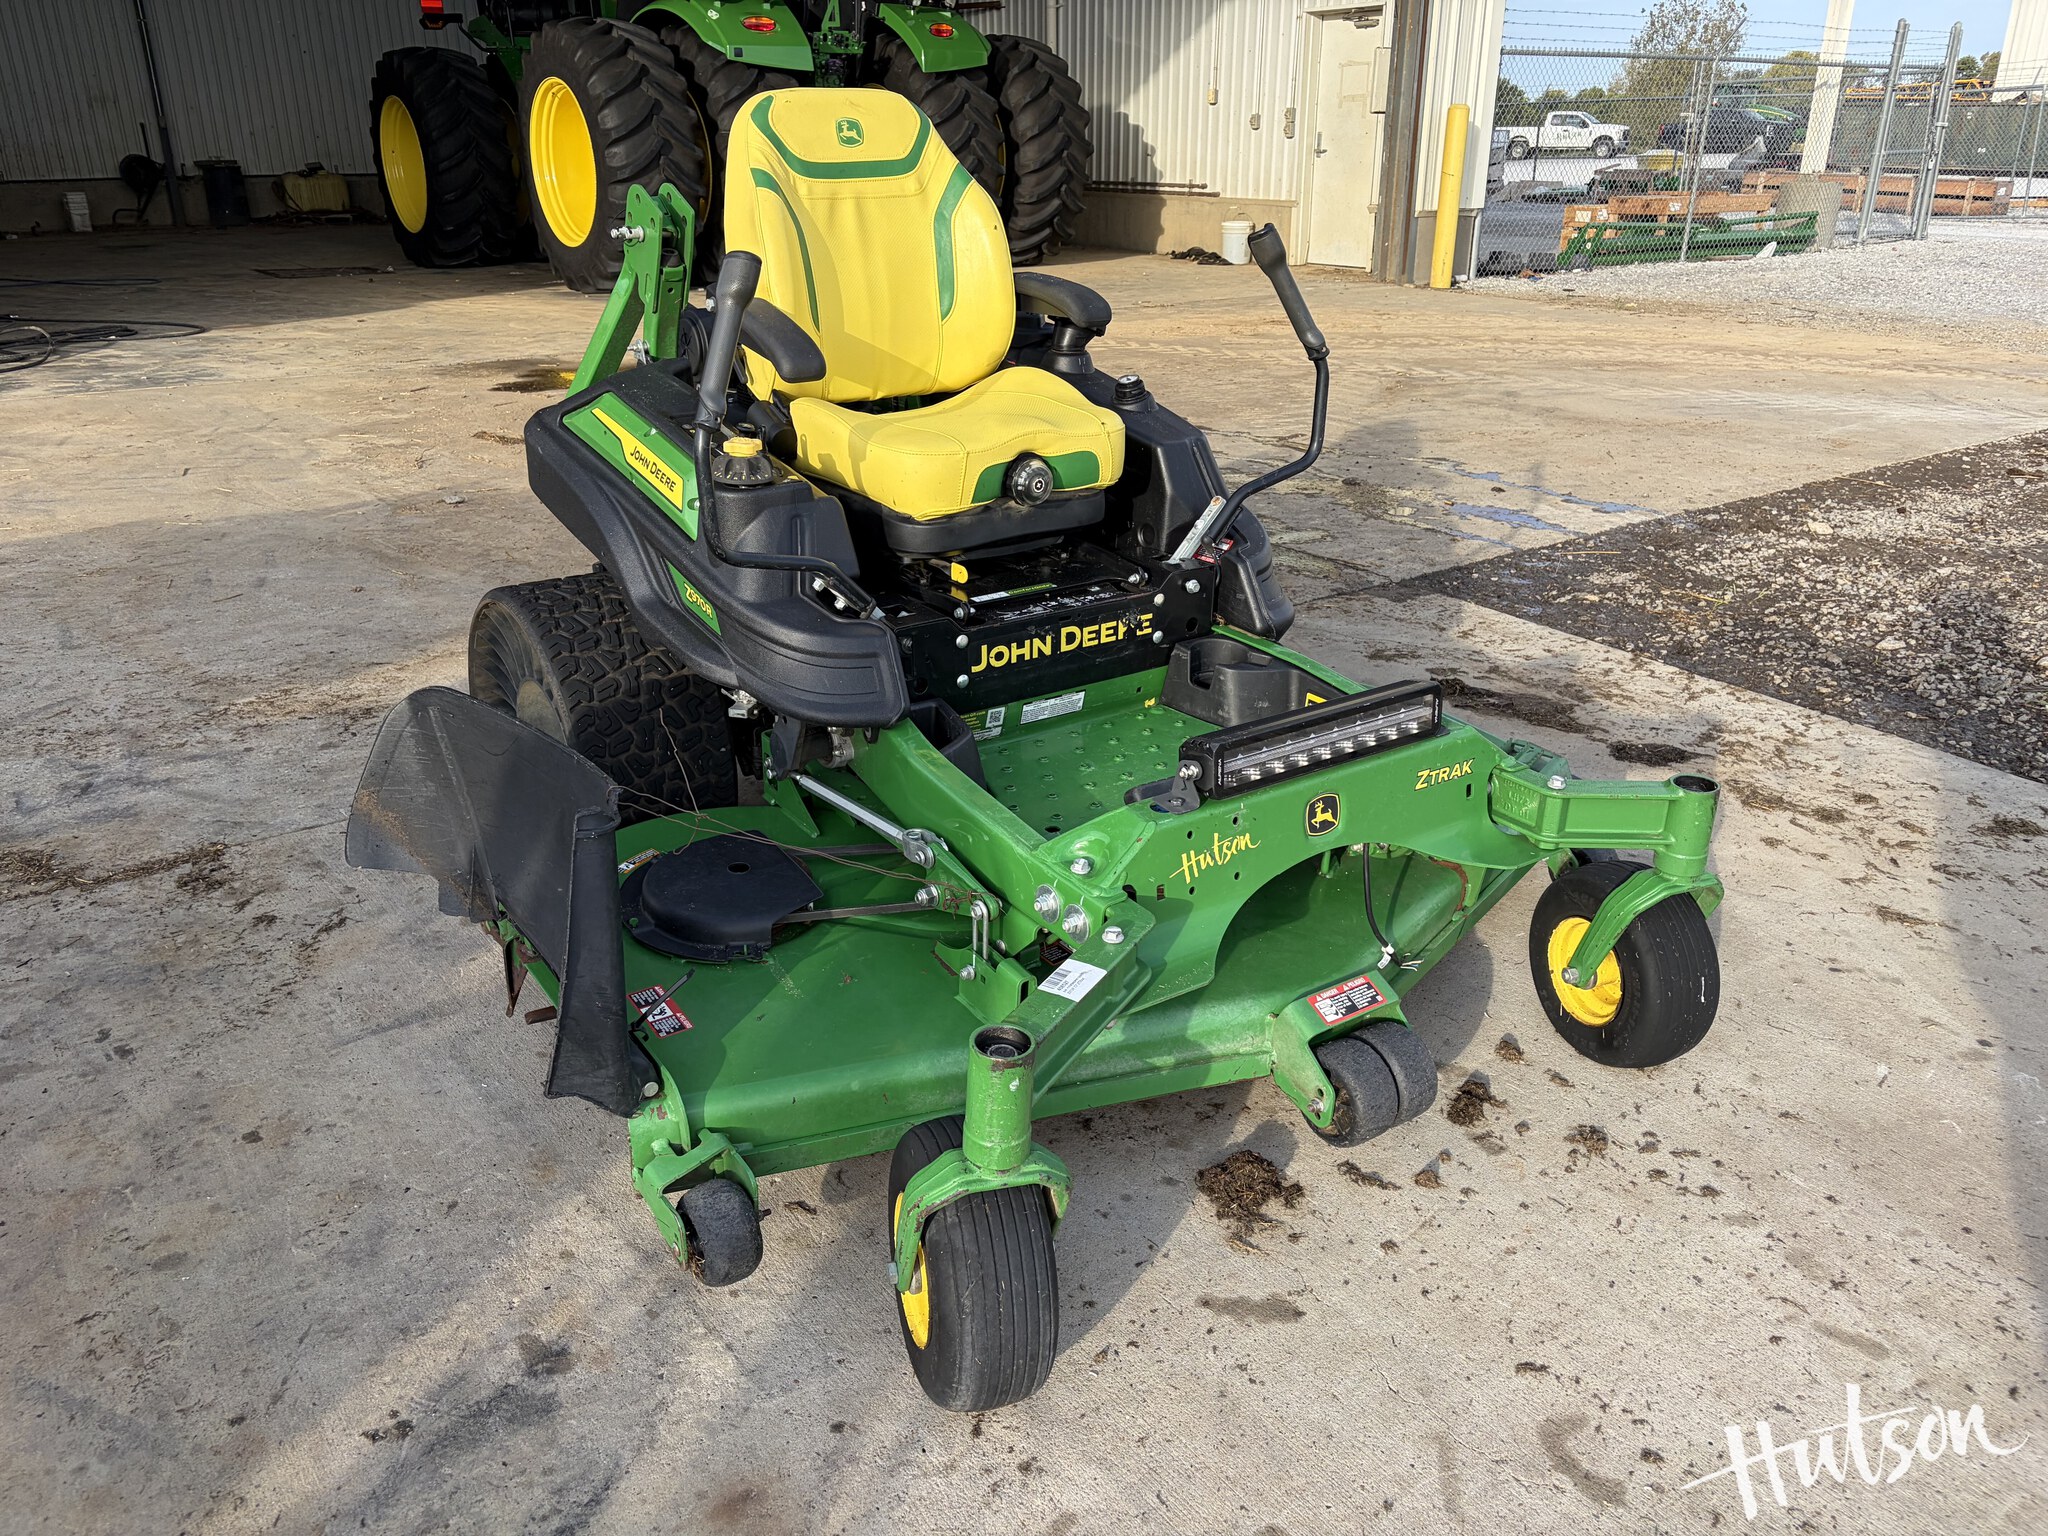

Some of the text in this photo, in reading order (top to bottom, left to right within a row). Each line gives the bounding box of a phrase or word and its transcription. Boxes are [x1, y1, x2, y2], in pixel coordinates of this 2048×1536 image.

[630, 446, 677, 492] JOHN DEERE
[971, 633, 1052, 673] JOHN
[1414, 758, 1475, 791] ZTRAK
[1169, 832, 1262, 885] Hutson
